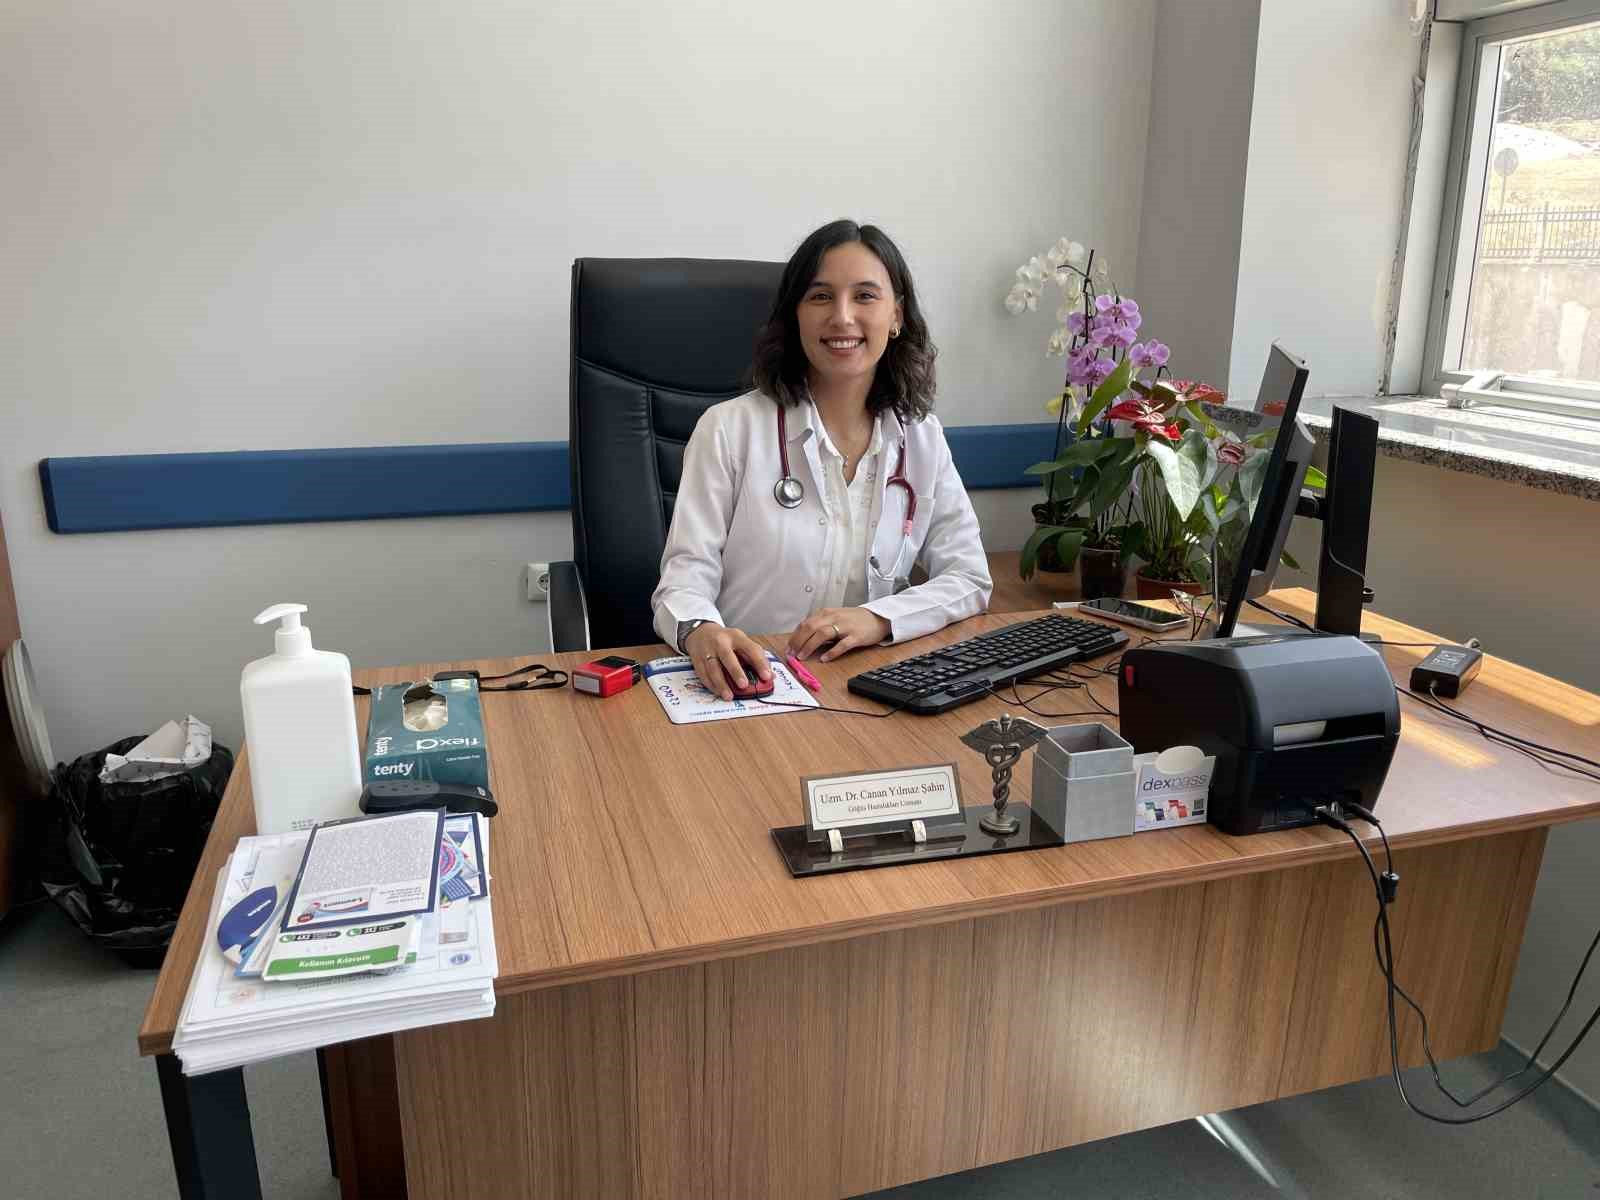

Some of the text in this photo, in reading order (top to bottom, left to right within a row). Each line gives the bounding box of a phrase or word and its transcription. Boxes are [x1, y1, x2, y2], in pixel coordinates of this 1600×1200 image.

[374, 736, 393, 756] tenty
[373, 761, 414, 776] tenty
[1143, 775, 1208, 791] dexpass
[820, 794, 843, 803] Uzm.
[845, 791, 859, 801] Dr.
[860, 790, 888, 799] Canan
